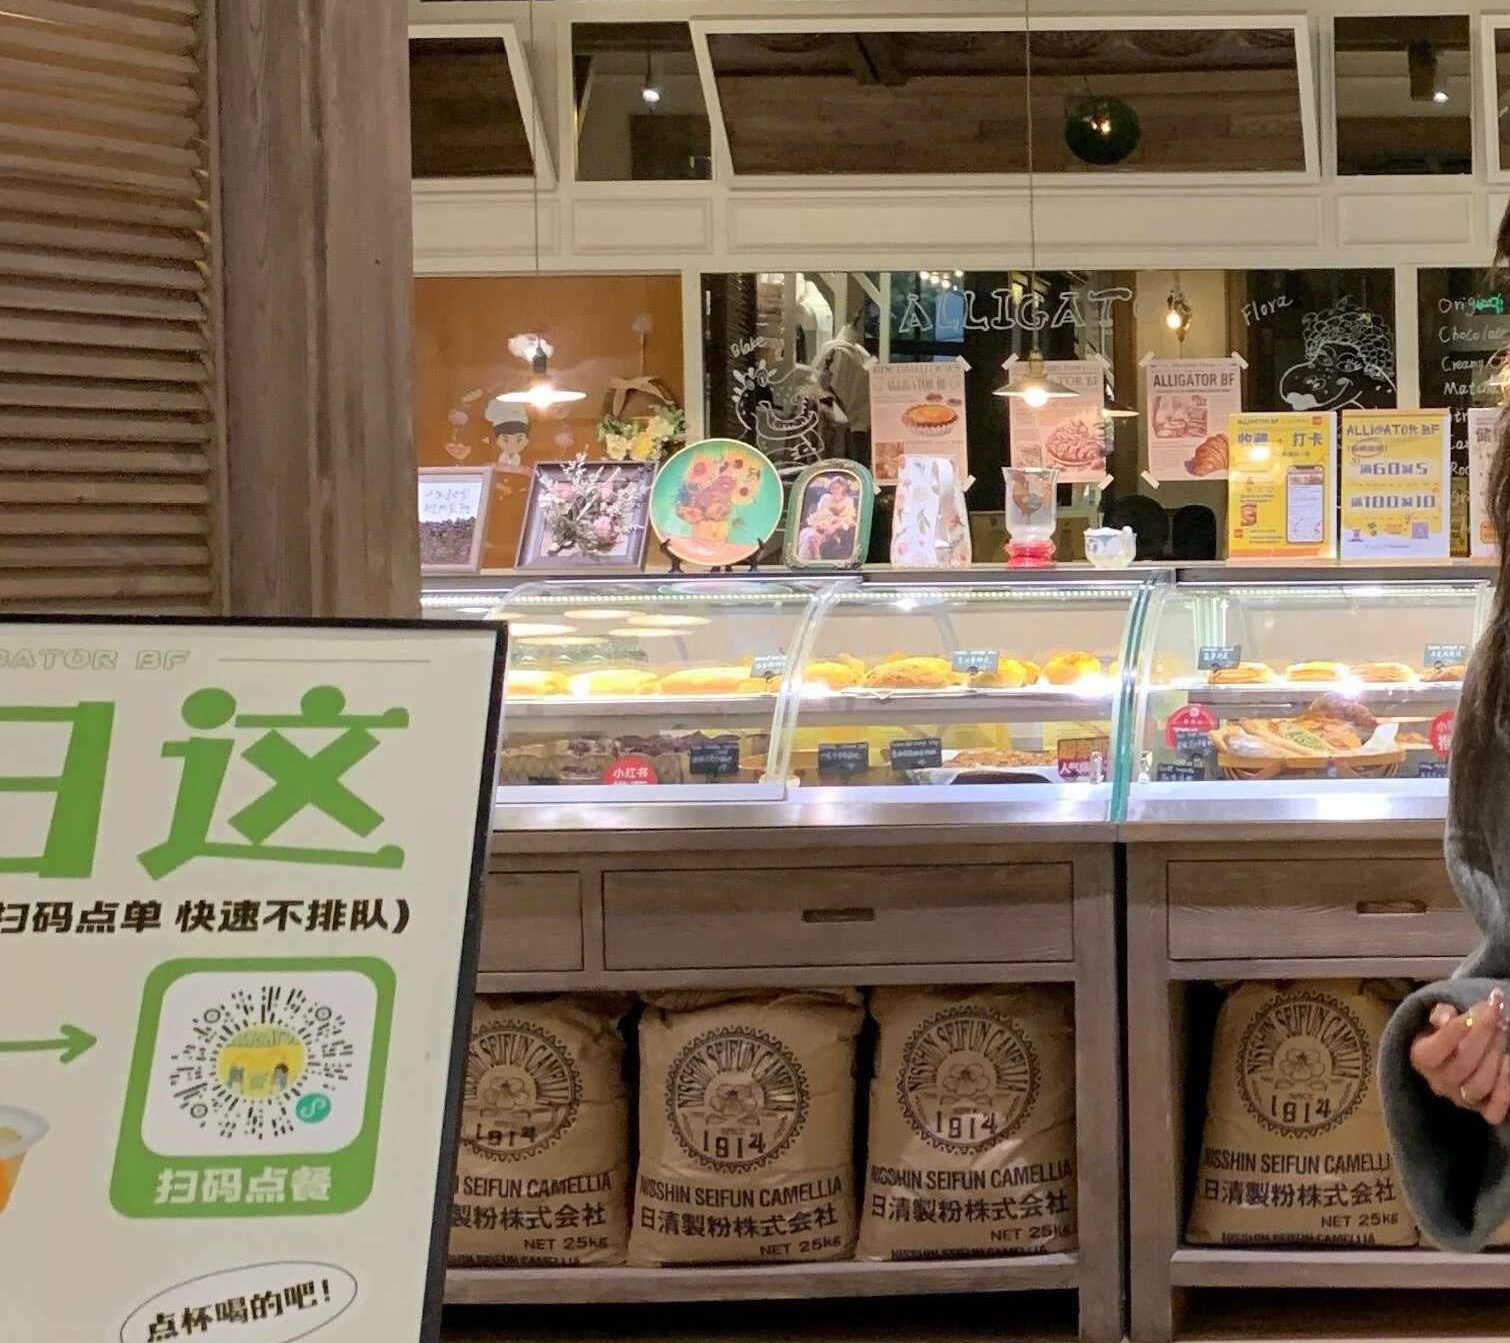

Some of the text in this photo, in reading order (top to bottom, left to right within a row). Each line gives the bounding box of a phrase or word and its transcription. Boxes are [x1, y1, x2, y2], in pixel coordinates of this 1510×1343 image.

[899, 287, 1138, 333] ALLIGAT
[1241, 295, 1293, 326] Flora
[730, 335, 767, 358] Blake
[1438, 325, 1508, 343] Chocolate
[1153, 372, 1236, 387] ALLIGATOR BF
[1347, 424, 1440, 436] ALLIGATOR BF
[136, 649, 191, 670] BF
[613, 767, 649, 778] 小红书
[926, 1170, 986, 1190] SEIFUN
[990, 1159, 1072, 1188] CAMELLIA
[1203, 1148, 1393, 1175] NISSHIN SEIFUN CAMELLI
[153, 1165, 333, 1205] 扫码点餐
[463, 1171, 613, 1199] SEIFUN CAMELLIA
[639, 1174, 843, 1208] NISSHIN SEIFUN CAMELLIA
[1205, 1178, 1396, 1208] 日清製粉株式会社
[871, 1189, 1072, 1223] 日清製粉株式会社
[641, 1202, 839, 1238] 日清製粉株式会社
[1321, 1215, 1352, 1228] NET
[524, 1237, 557, 1251] NET
[990, 1229, 1023, 1242] NET
[760, 1243, 792, 1256] NET
[146, 1278, 332, 1343] 点杯喝的吧!
